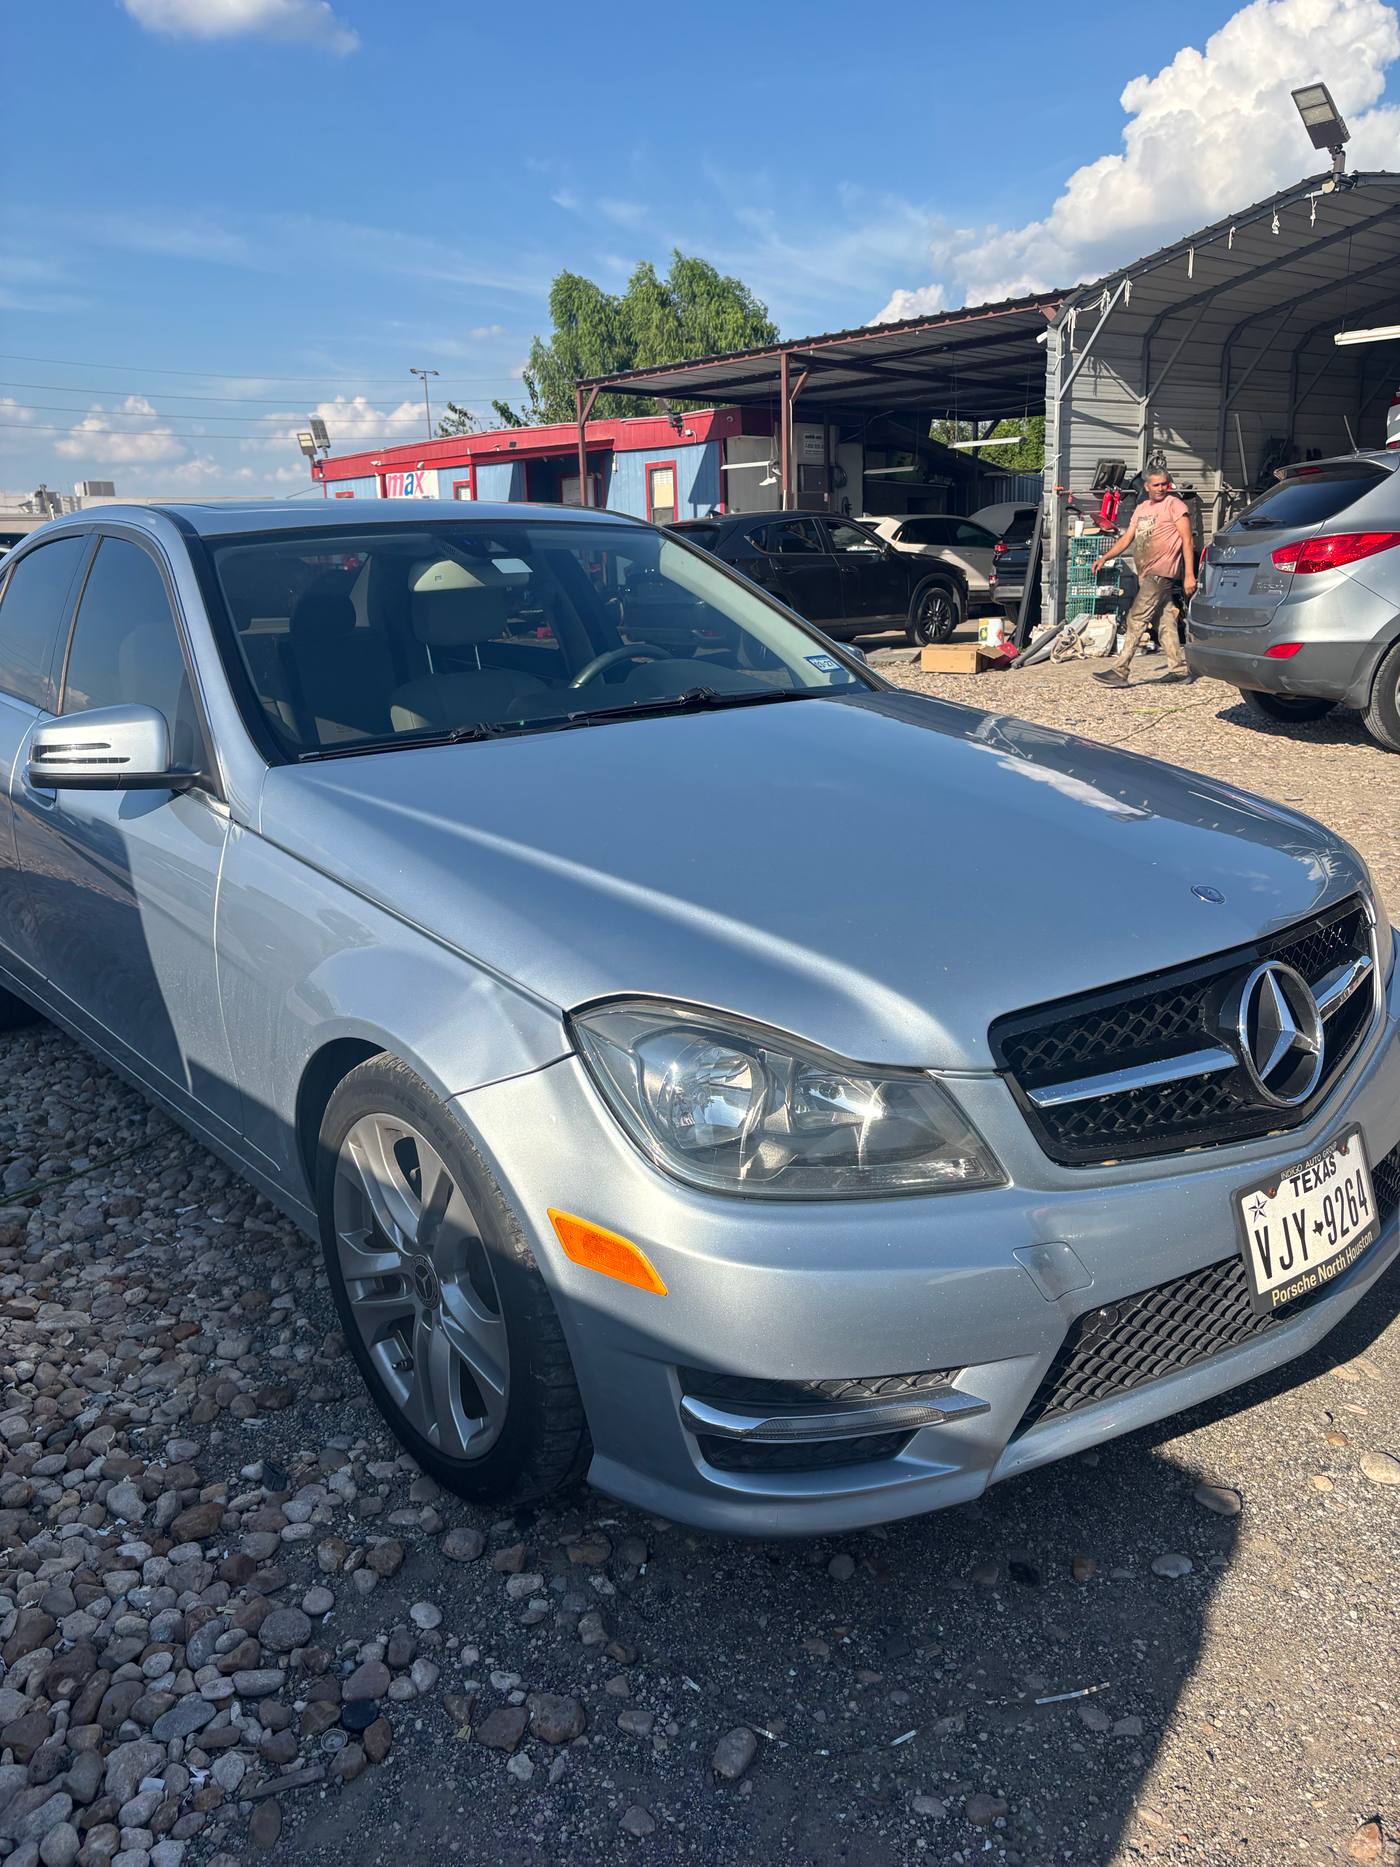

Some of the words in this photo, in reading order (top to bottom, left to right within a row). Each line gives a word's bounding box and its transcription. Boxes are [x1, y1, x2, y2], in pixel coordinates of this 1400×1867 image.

[1281, 1164, 1302, 1180] INDIGO
[1305, 1154, 1323, 1168] AUTO
[1322, 1141, 1338, 1159] GROUP
[1289, 1156, 1337, 1198] TEXAS
[1254, 1208, 1309, 1280] VJY
[1322, 1168, 1369, 1246] 9264
[1271, 1272, 1317, 1306] Porsche
[1318, 1255, 1347, 1280] North
[1345, 1231, 1373, 1265] Houston
